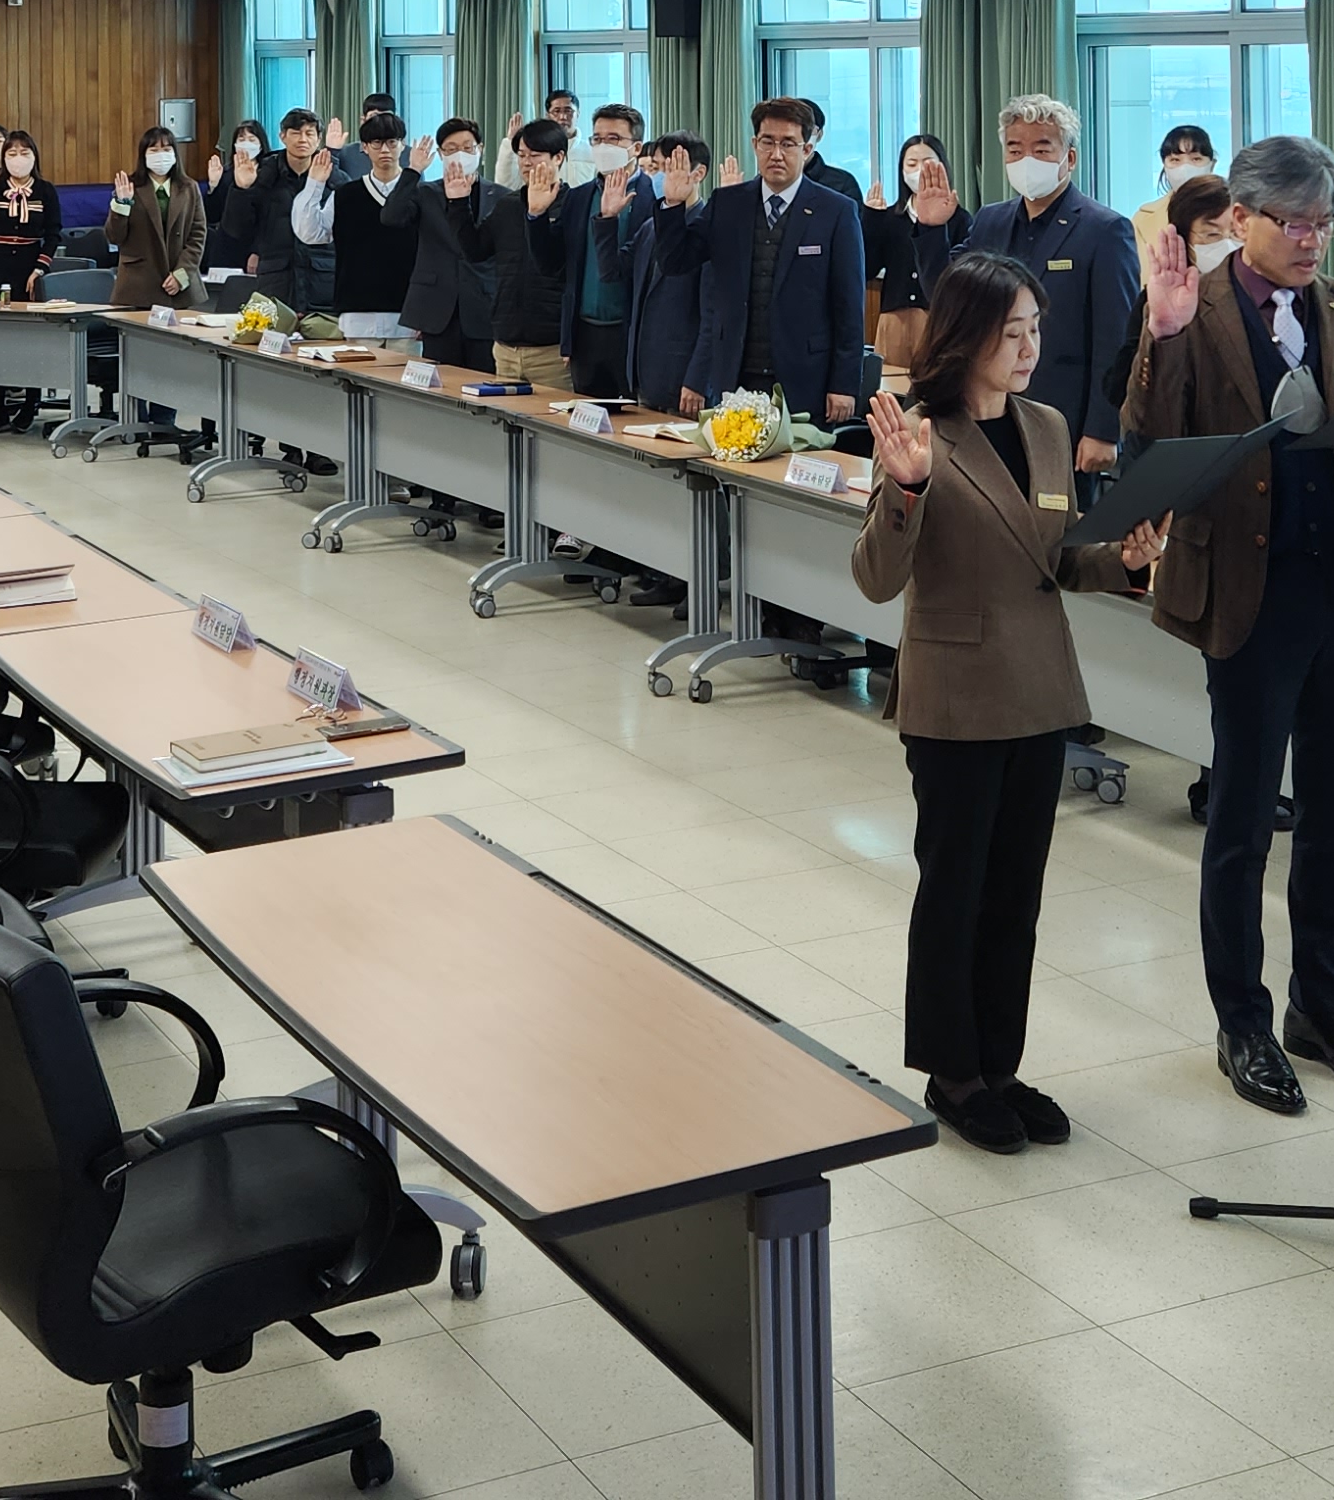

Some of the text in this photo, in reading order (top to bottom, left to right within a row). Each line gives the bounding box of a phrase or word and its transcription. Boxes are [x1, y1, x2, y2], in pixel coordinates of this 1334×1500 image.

[791, 467, 832, 489] 중등교육담당
[198, 611, 234, 643] 행정지원담당
[293, 667, 337, 704] 행정지원과장
